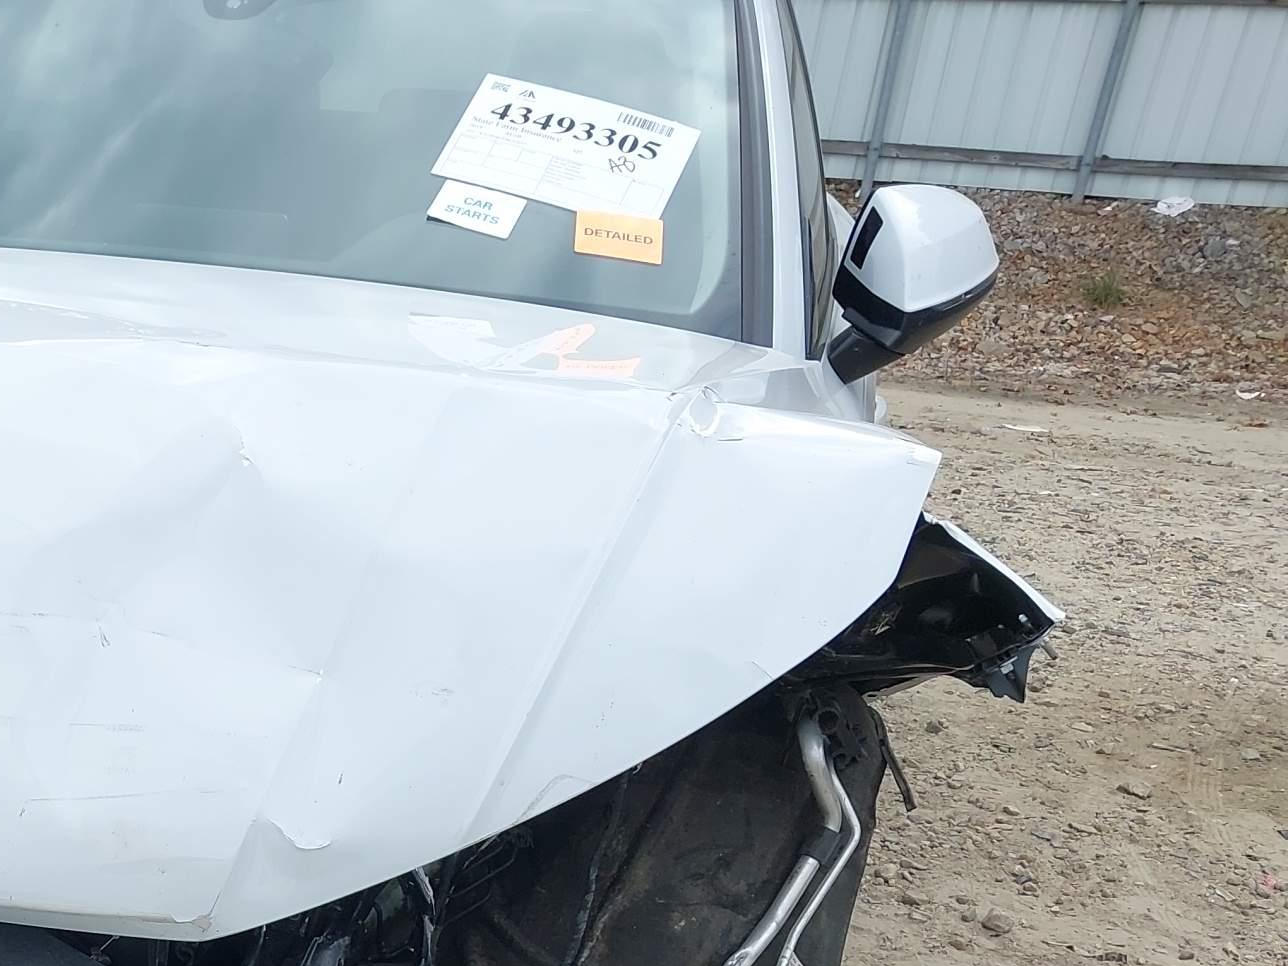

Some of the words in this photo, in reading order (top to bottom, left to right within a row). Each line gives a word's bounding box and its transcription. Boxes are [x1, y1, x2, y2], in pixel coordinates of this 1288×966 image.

[491, 103, 662, 160] 43493305
[463, 197, 493, 211] CAR
[444, 205, 500, 225] STARTS
[584, 227, 654, 245] DETAILED
